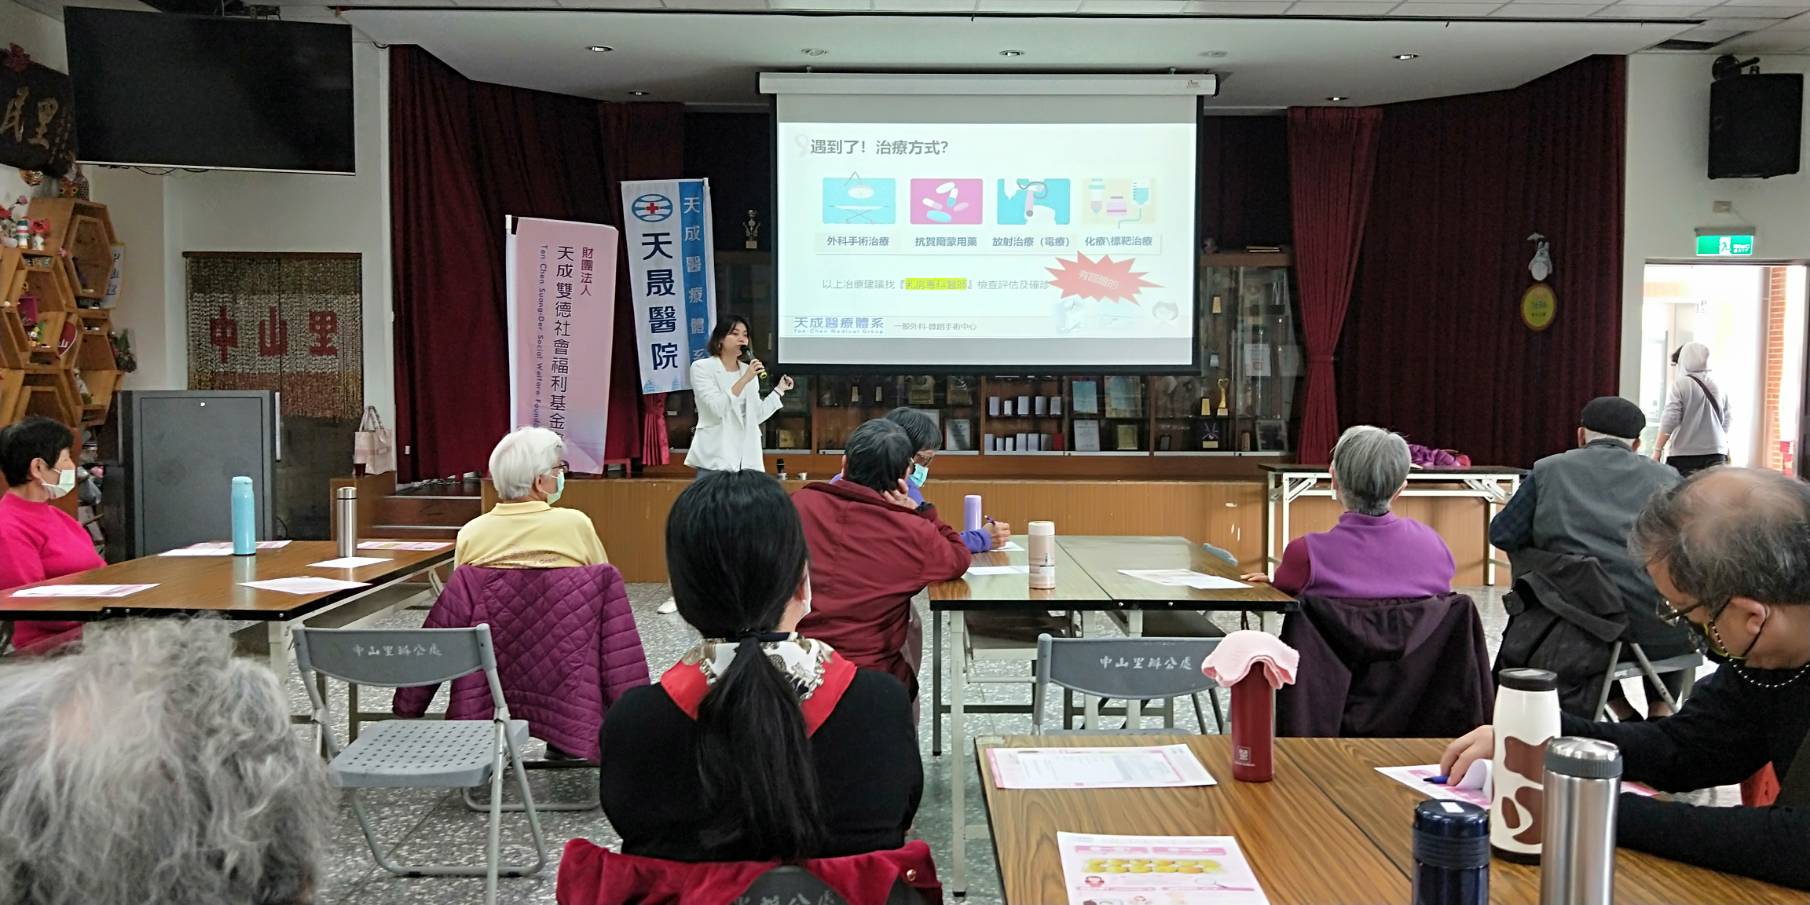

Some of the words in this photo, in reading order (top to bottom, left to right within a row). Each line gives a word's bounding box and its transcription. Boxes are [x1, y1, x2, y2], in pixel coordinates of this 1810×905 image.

[540, 244, 549, 260] Ten
[826, 236, 889, 247] 外科手術治療
[915, 236, 977, 247] 抗賀爾蒙用藥
[538, 263, 547, 287] Chen
[580, 246, 594, 298] 財團法人
[683, 196, 706, 362] 天成醫療體系
[641, 231, 679, 370] 天晟醫院
[209, 304, 338, 364] 中山里
[793, 317, 884, 328] 天成醫療體系
[535, 335, 544, 359] Social
[534, 363, 544, 396] Welfare
[1099, 655, 1193, 671] 中山里辦公處
